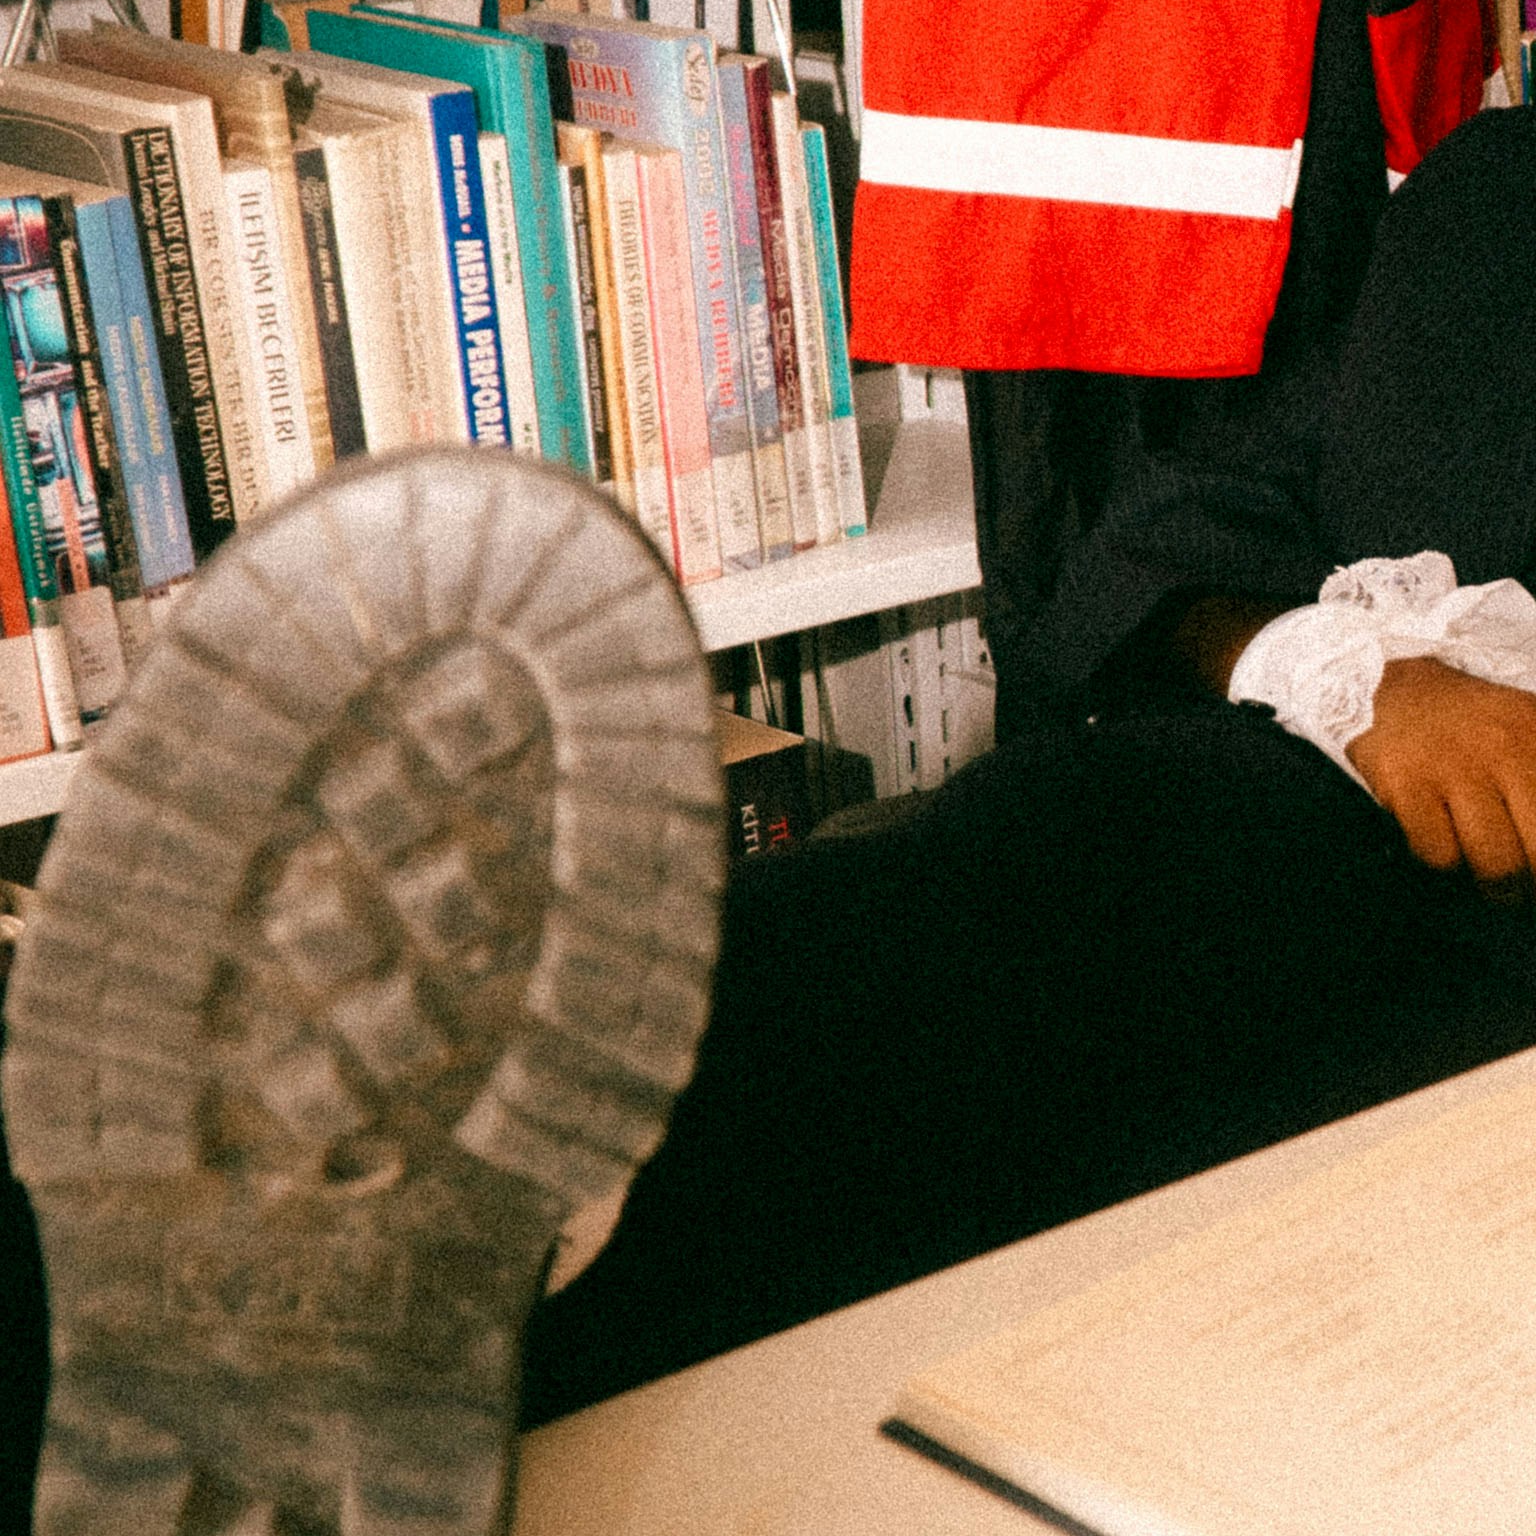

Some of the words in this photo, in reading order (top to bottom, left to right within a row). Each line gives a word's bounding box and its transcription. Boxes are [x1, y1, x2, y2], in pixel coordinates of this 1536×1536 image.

[148, 131, 180, 239] DICTIONARY
[148, 228, 163, 254] and
[152, 256, 170, 297] Michael
[167, 242, 187, 267] OF
[454, 236, 492, 325] MEDIA
[618, 198, 641, 283] THEORIES
[701, 208, 723, 289] MEDYA
[769, 218, 788, 297] Media
[62, 238, 91, 354] Communication
[171, 268, 210, 399] INFORMATION
[624, 285, 644, 308] OF
[82, 358, 98, 385] and
[628, 310, 658, 445] COMMUNICATION
[747, 302, 772, 391] MEDIA
[87, 387, 102, 411] the
[91, 414, 110, 470] Teacher
[192, 400, 231, 524] TECHNOLOGY
